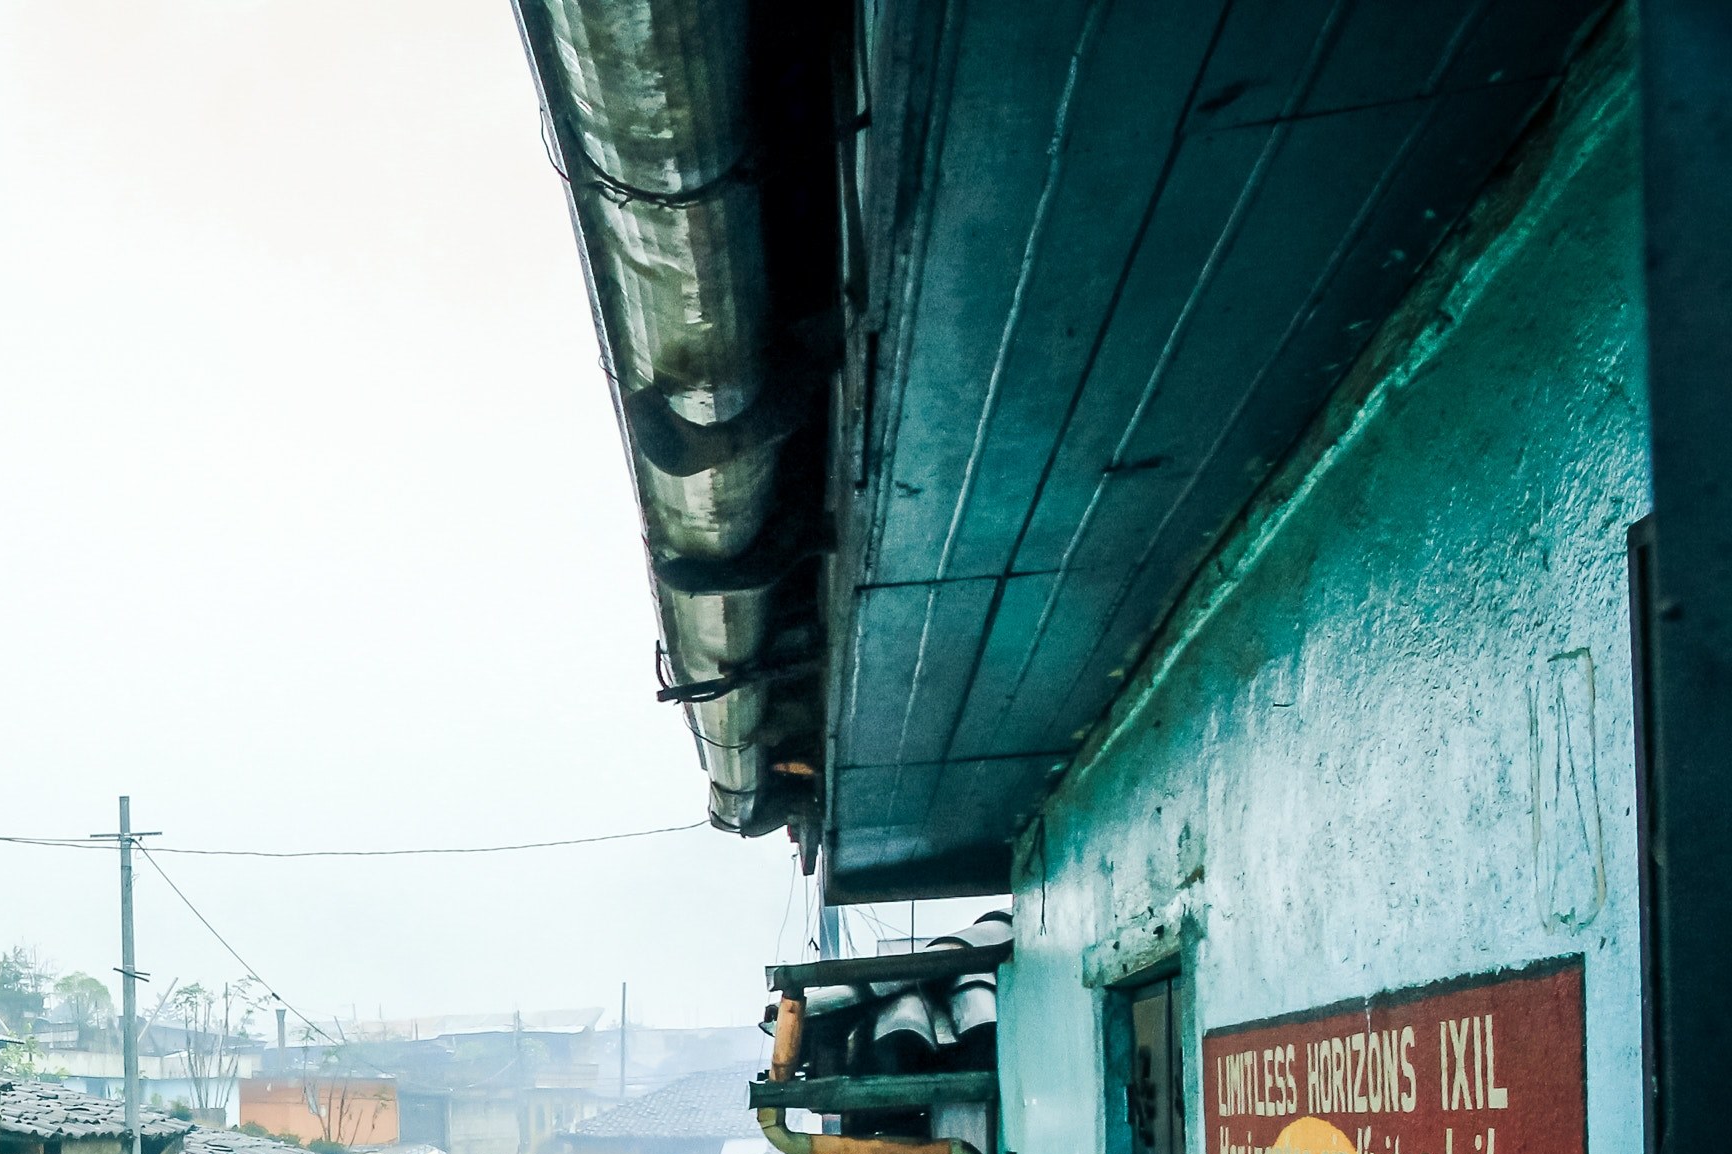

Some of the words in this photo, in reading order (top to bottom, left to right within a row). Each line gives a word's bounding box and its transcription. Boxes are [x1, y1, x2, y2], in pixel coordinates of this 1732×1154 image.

[1217, 1044, 1298, 1117] LIMITLESS
[1306, 1025, 1417, 1114] HORIZONS
[1439, 1014, 1508, 1111] IXIL
